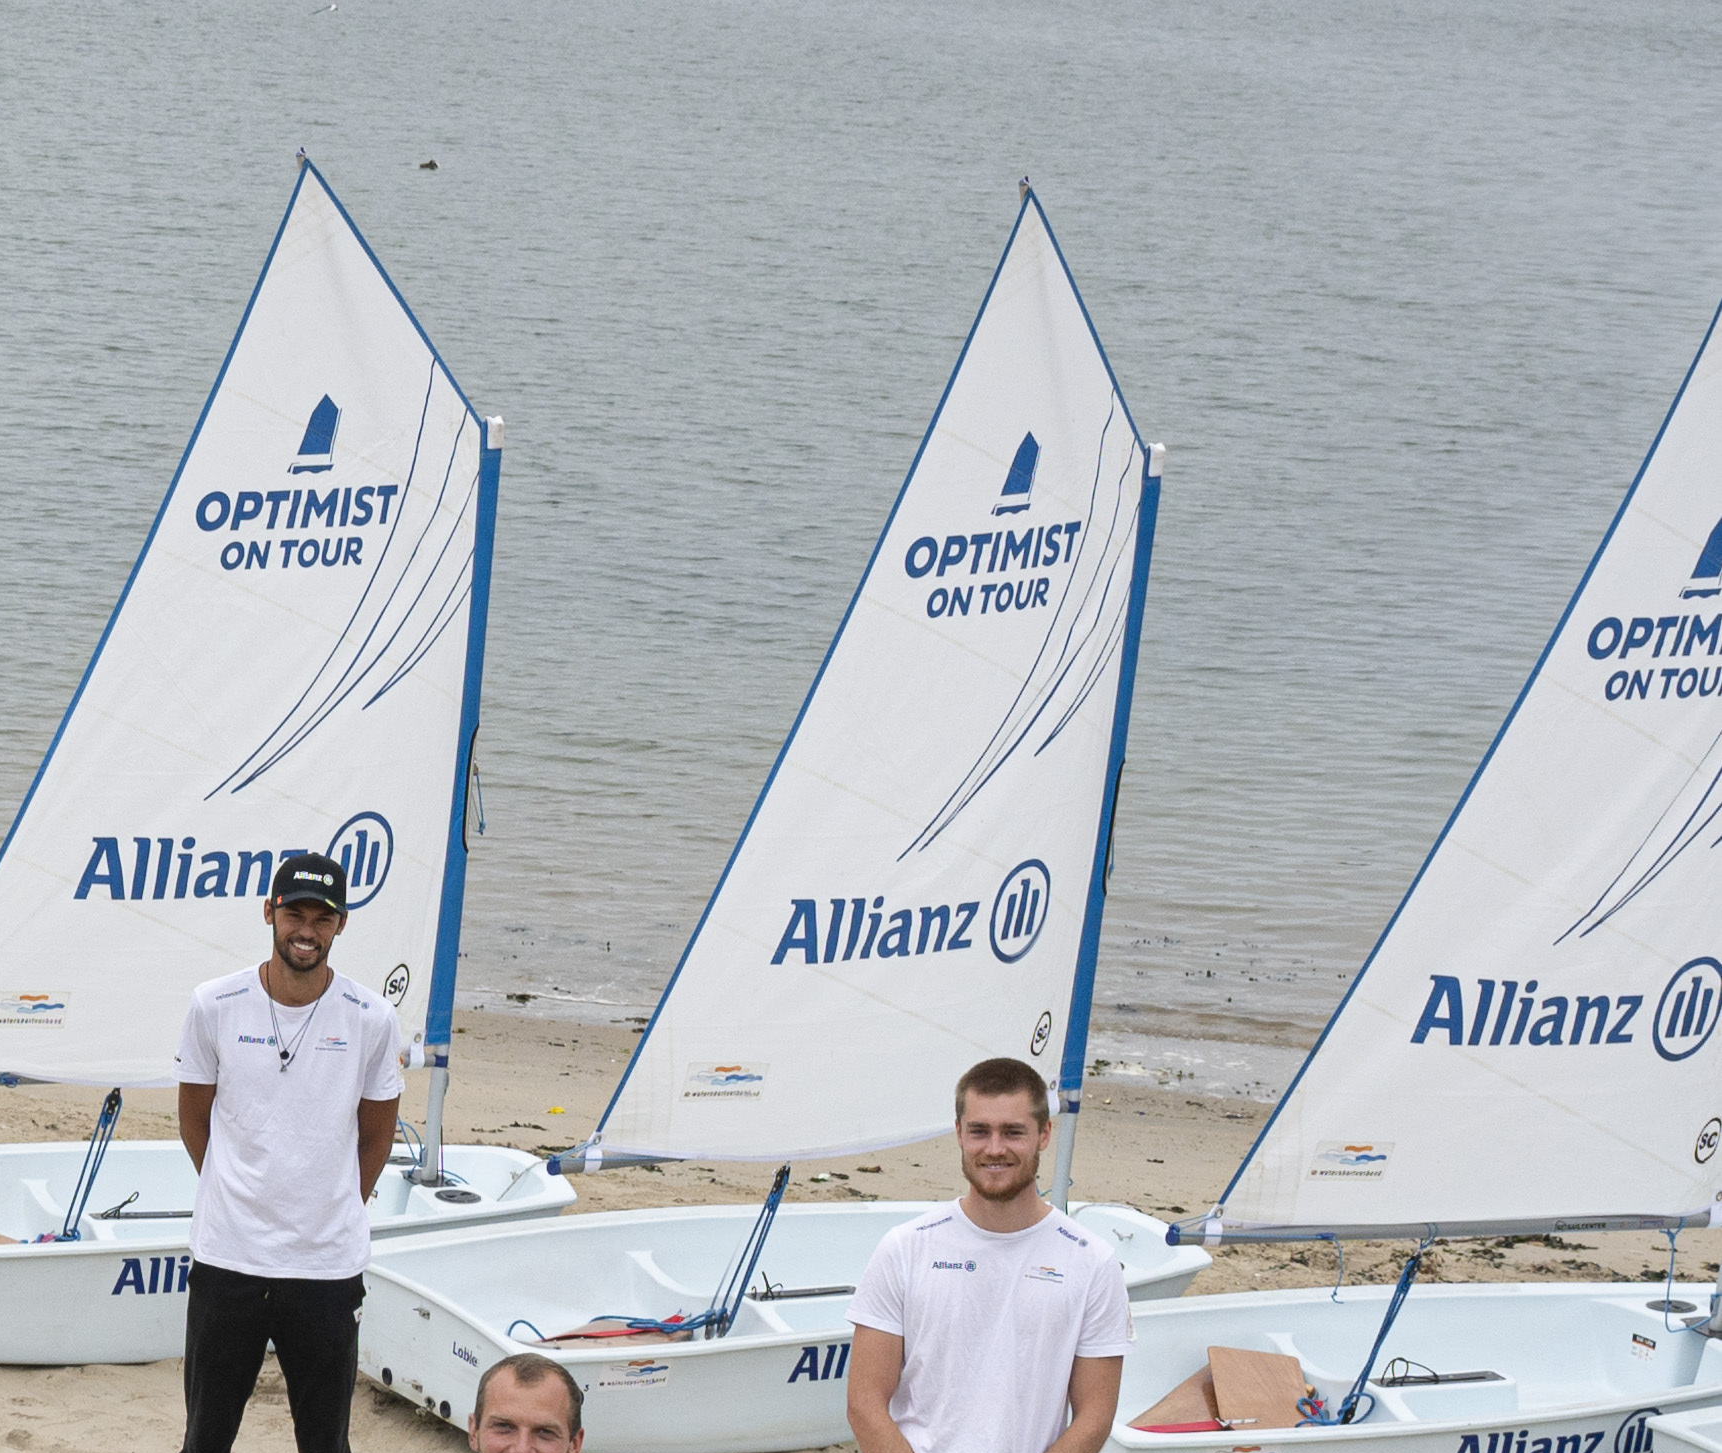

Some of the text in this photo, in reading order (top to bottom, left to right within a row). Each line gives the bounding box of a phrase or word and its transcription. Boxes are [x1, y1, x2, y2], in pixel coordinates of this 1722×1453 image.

[196, 484, 398, 532] OPTIMIST
[220, 537, 363, 570] ON TOUR
[905, 520, 1081, 579] OPTIMIST
[926, 577, 1050, 618] ON TOUR
[1587, 613, 1722, 660] OPTIM
[1605, 666, 1722, 701] ON TOU
[294, 871, 322, 881] Allianz
[770, 895, 980, 965] Allianz
[388, 977, 405, 995] SC
[1410, 974, 1644, 1046] Allianz
[238, 1035, 265, 1044] Allianz
[1035, 1023, 1049, 1043] SC
[1698, 1132, 1716, 1149] SC
[111, 1256, 188, 1295] Alli
[932, 1261, 962, 1269] Allianz
